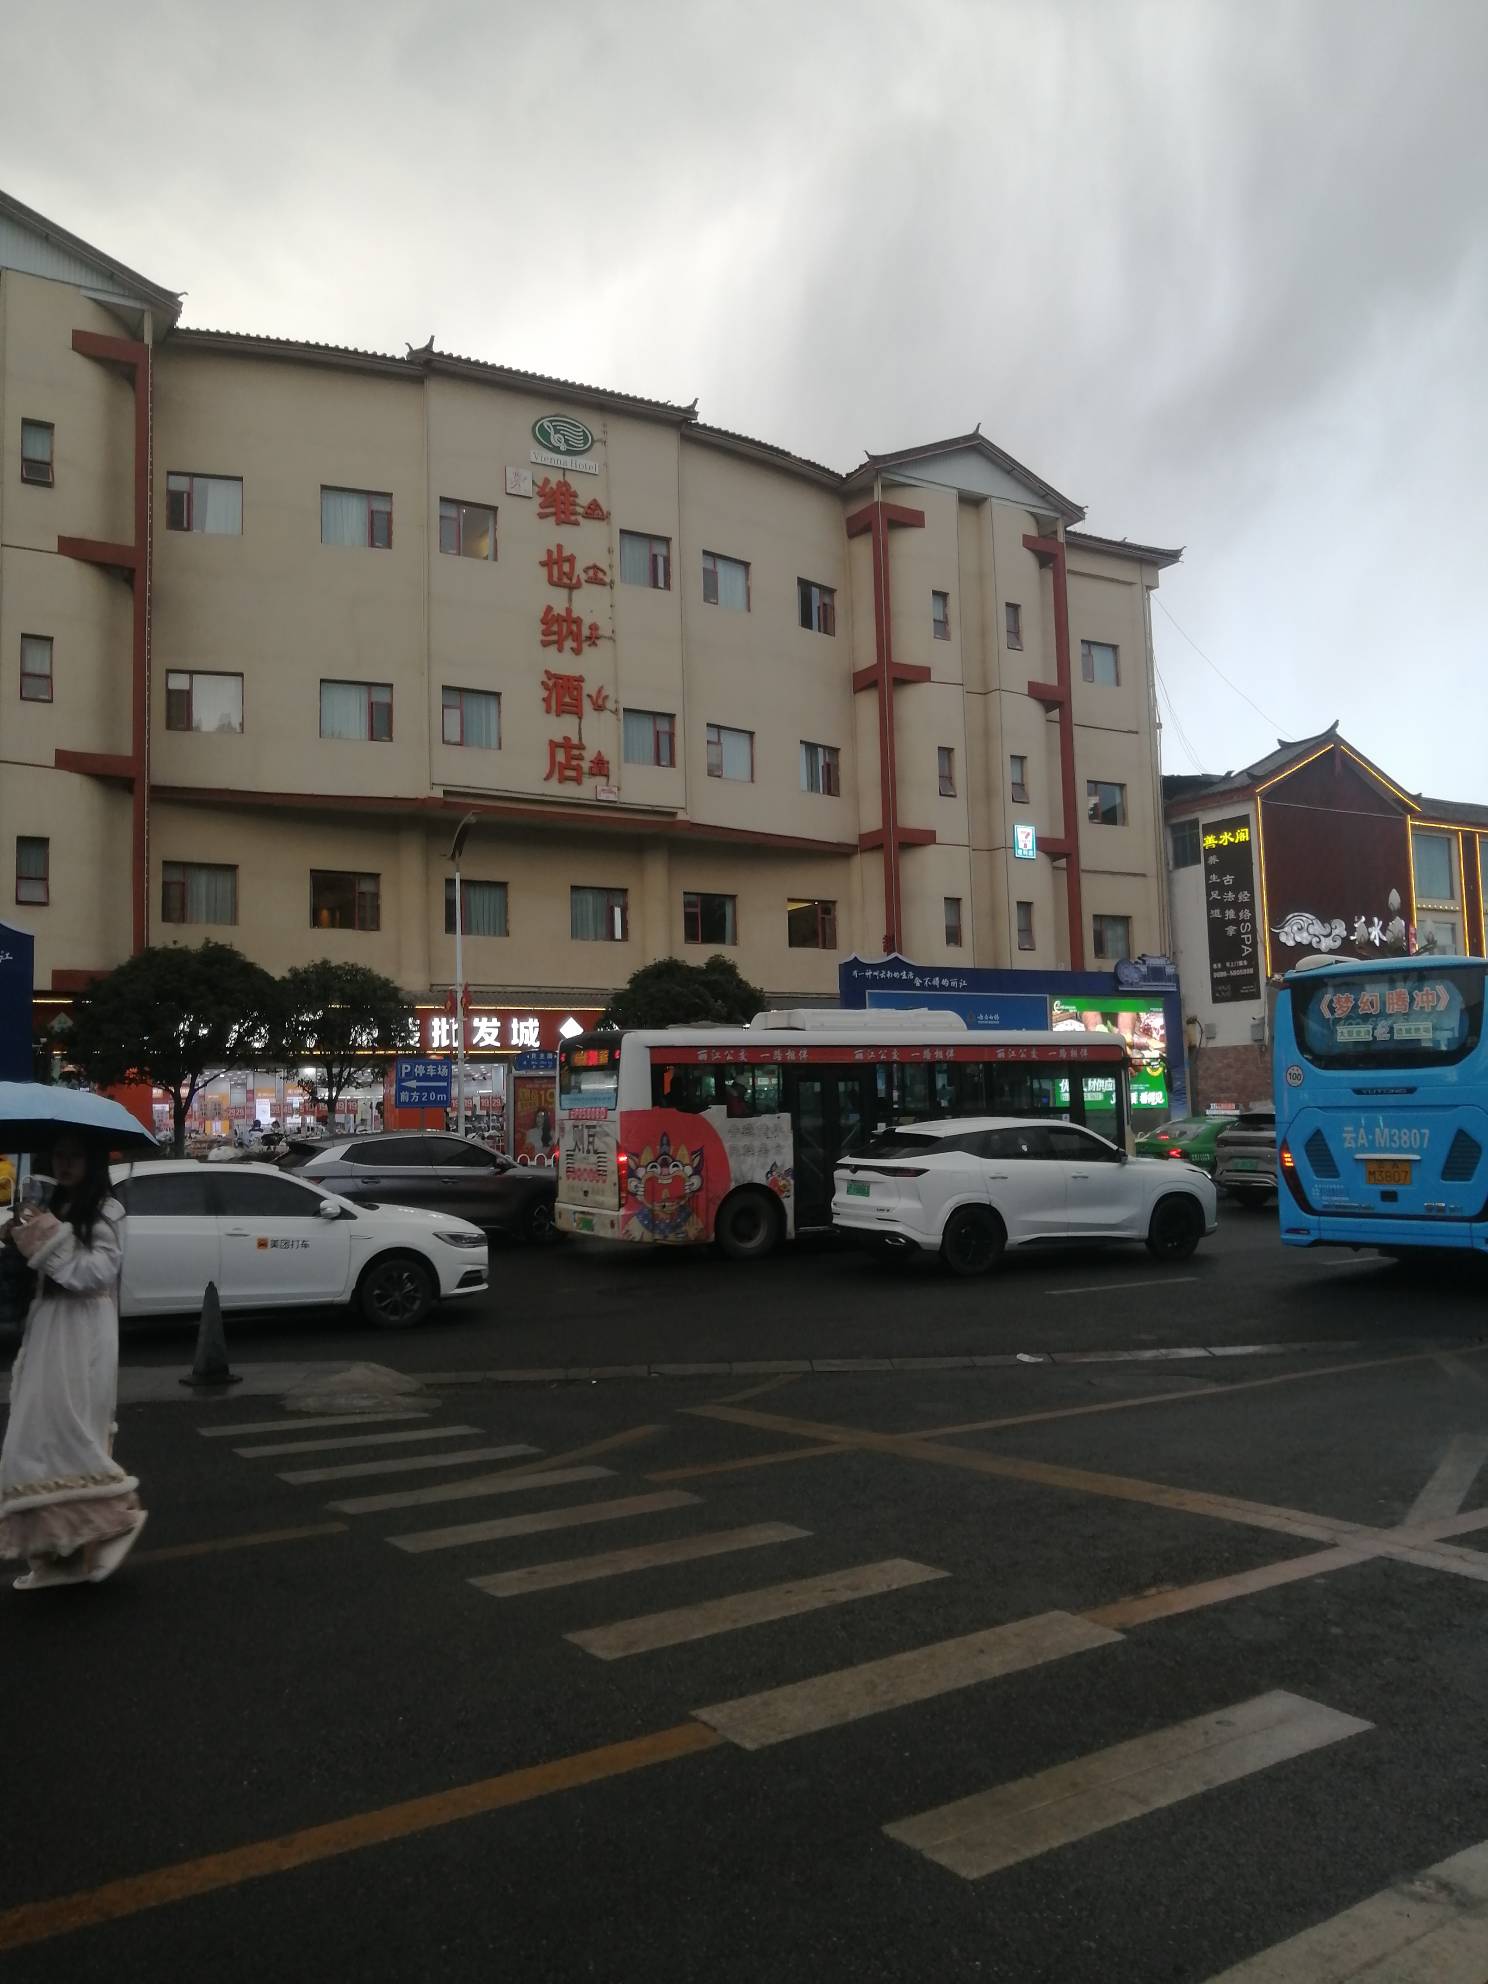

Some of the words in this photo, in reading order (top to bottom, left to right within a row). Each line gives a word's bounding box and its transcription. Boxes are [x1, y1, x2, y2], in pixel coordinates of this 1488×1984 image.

[569, 459, 598, 473] Hotel
[536, 476, 586, 785] 维也纳酒店
[1202, 828, 1250, 849] 善水阁
[1222, 875, 1238, 937] 古法推拿
[414, 1064, 449, 1077] 停车场
[1368, 1170, 1409, 1184] M3807
[270, 1239, 310, 1250] 美团打车
